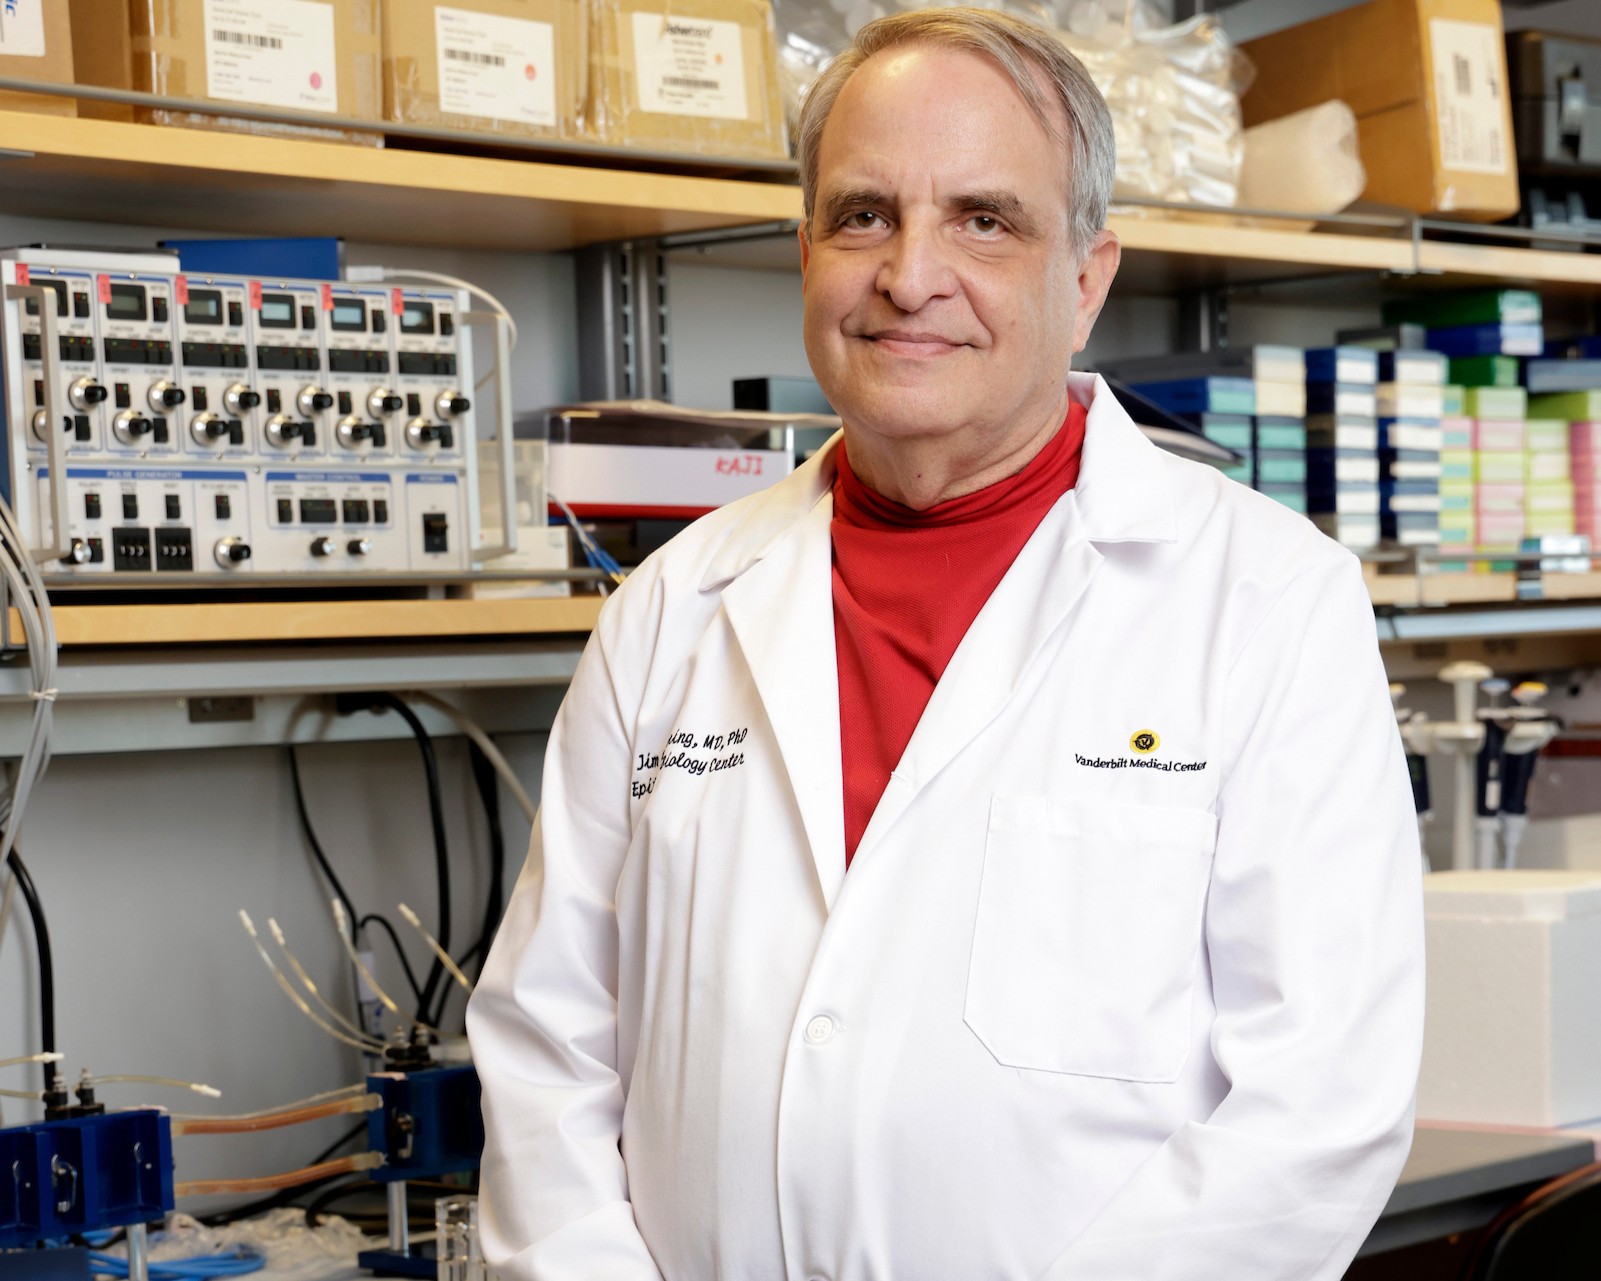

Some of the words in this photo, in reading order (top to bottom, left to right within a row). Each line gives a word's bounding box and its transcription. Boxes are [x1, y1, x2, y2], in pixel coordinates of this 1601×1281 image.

[106, 470, 133, 479] PULSE
[715, 454, 763, 476] KAJI
[637, 752, 659, 771] Jim
[703, 734, 724, 751] MD,
[727, 727, 748, 746] PhD
[709, 752, 745, 773] Center
[1075, 753, 1127, 769] Vanderbilt
[1129, 758, 1172, 771] Medical
[1173, 761, 1207, 772] Center
